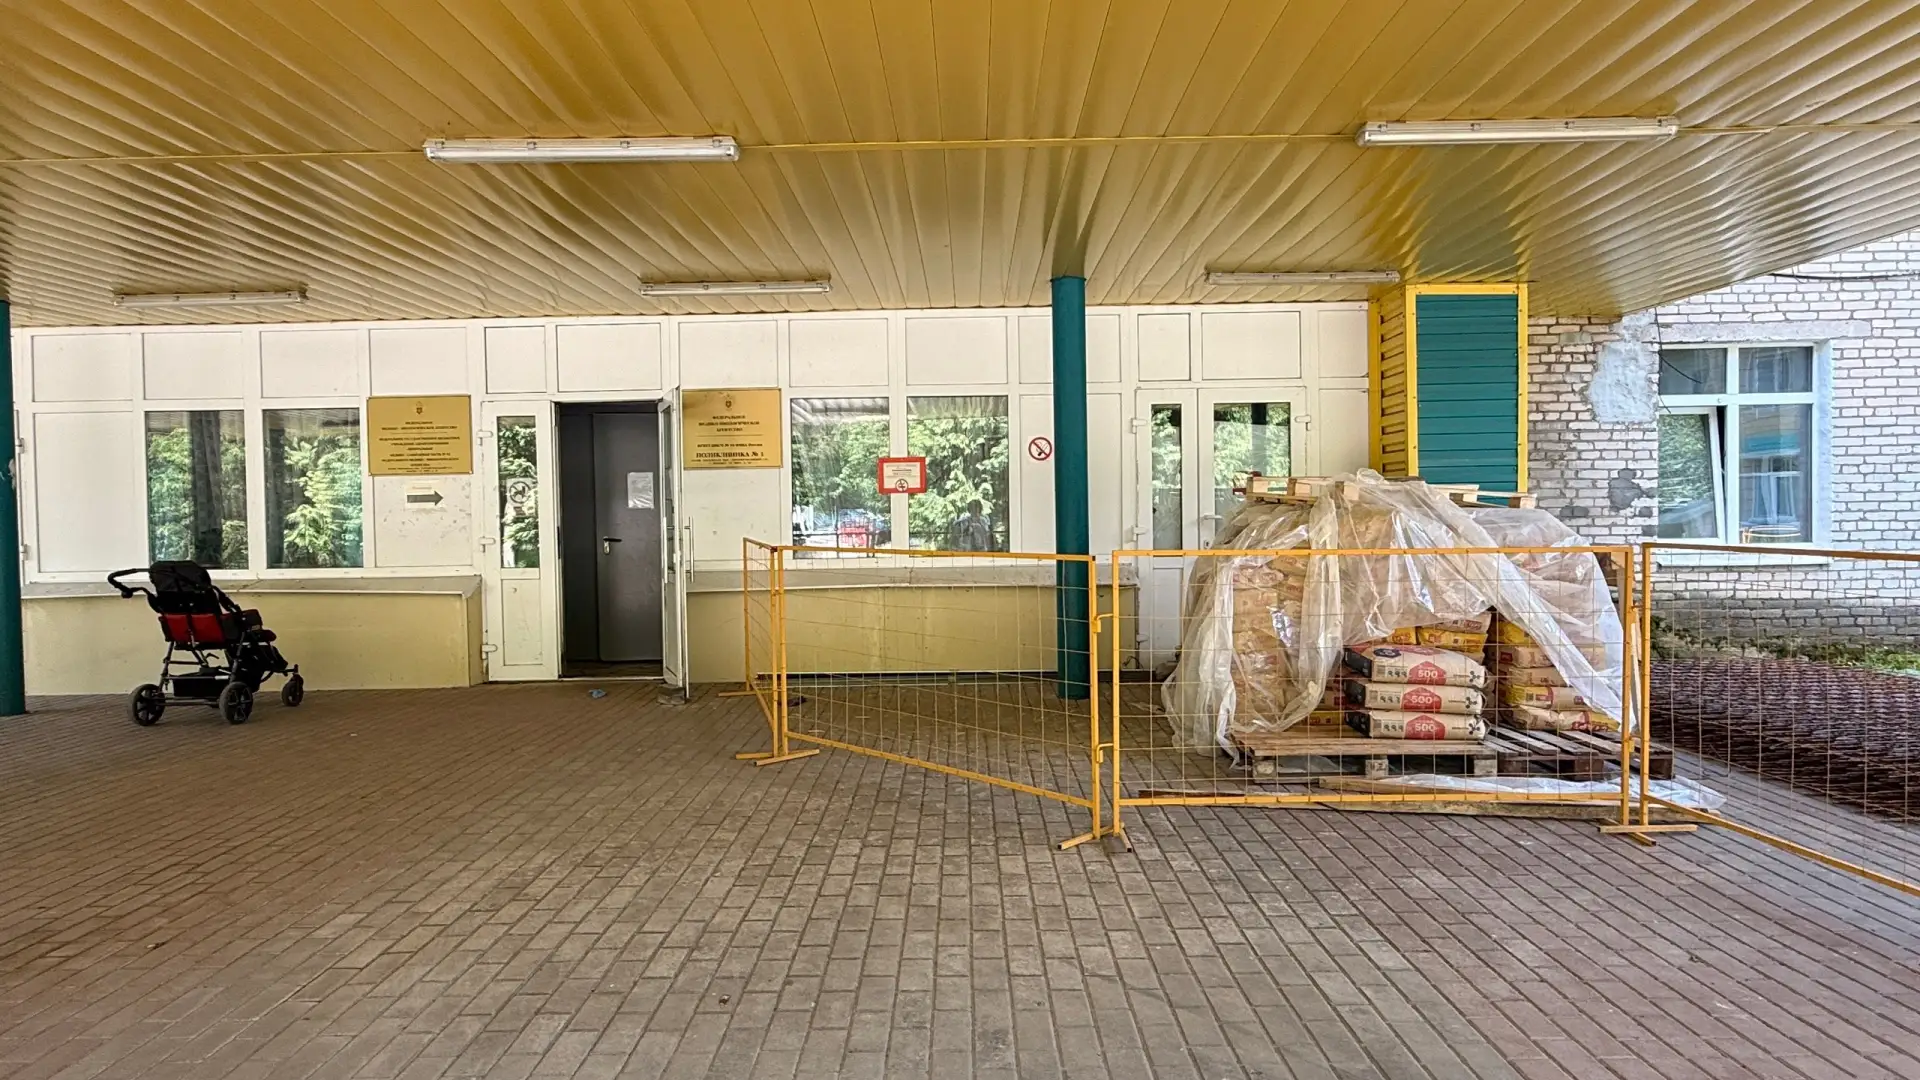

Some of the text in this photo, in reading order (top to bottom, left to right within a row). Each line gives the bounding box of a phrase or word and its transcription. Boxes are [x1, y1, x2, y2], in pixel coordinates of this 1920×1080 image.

[1418, 670, 1438, 678] 500
[1411, 695, 1433, 704] 500
[1414, 723, 1436, 732] 500
